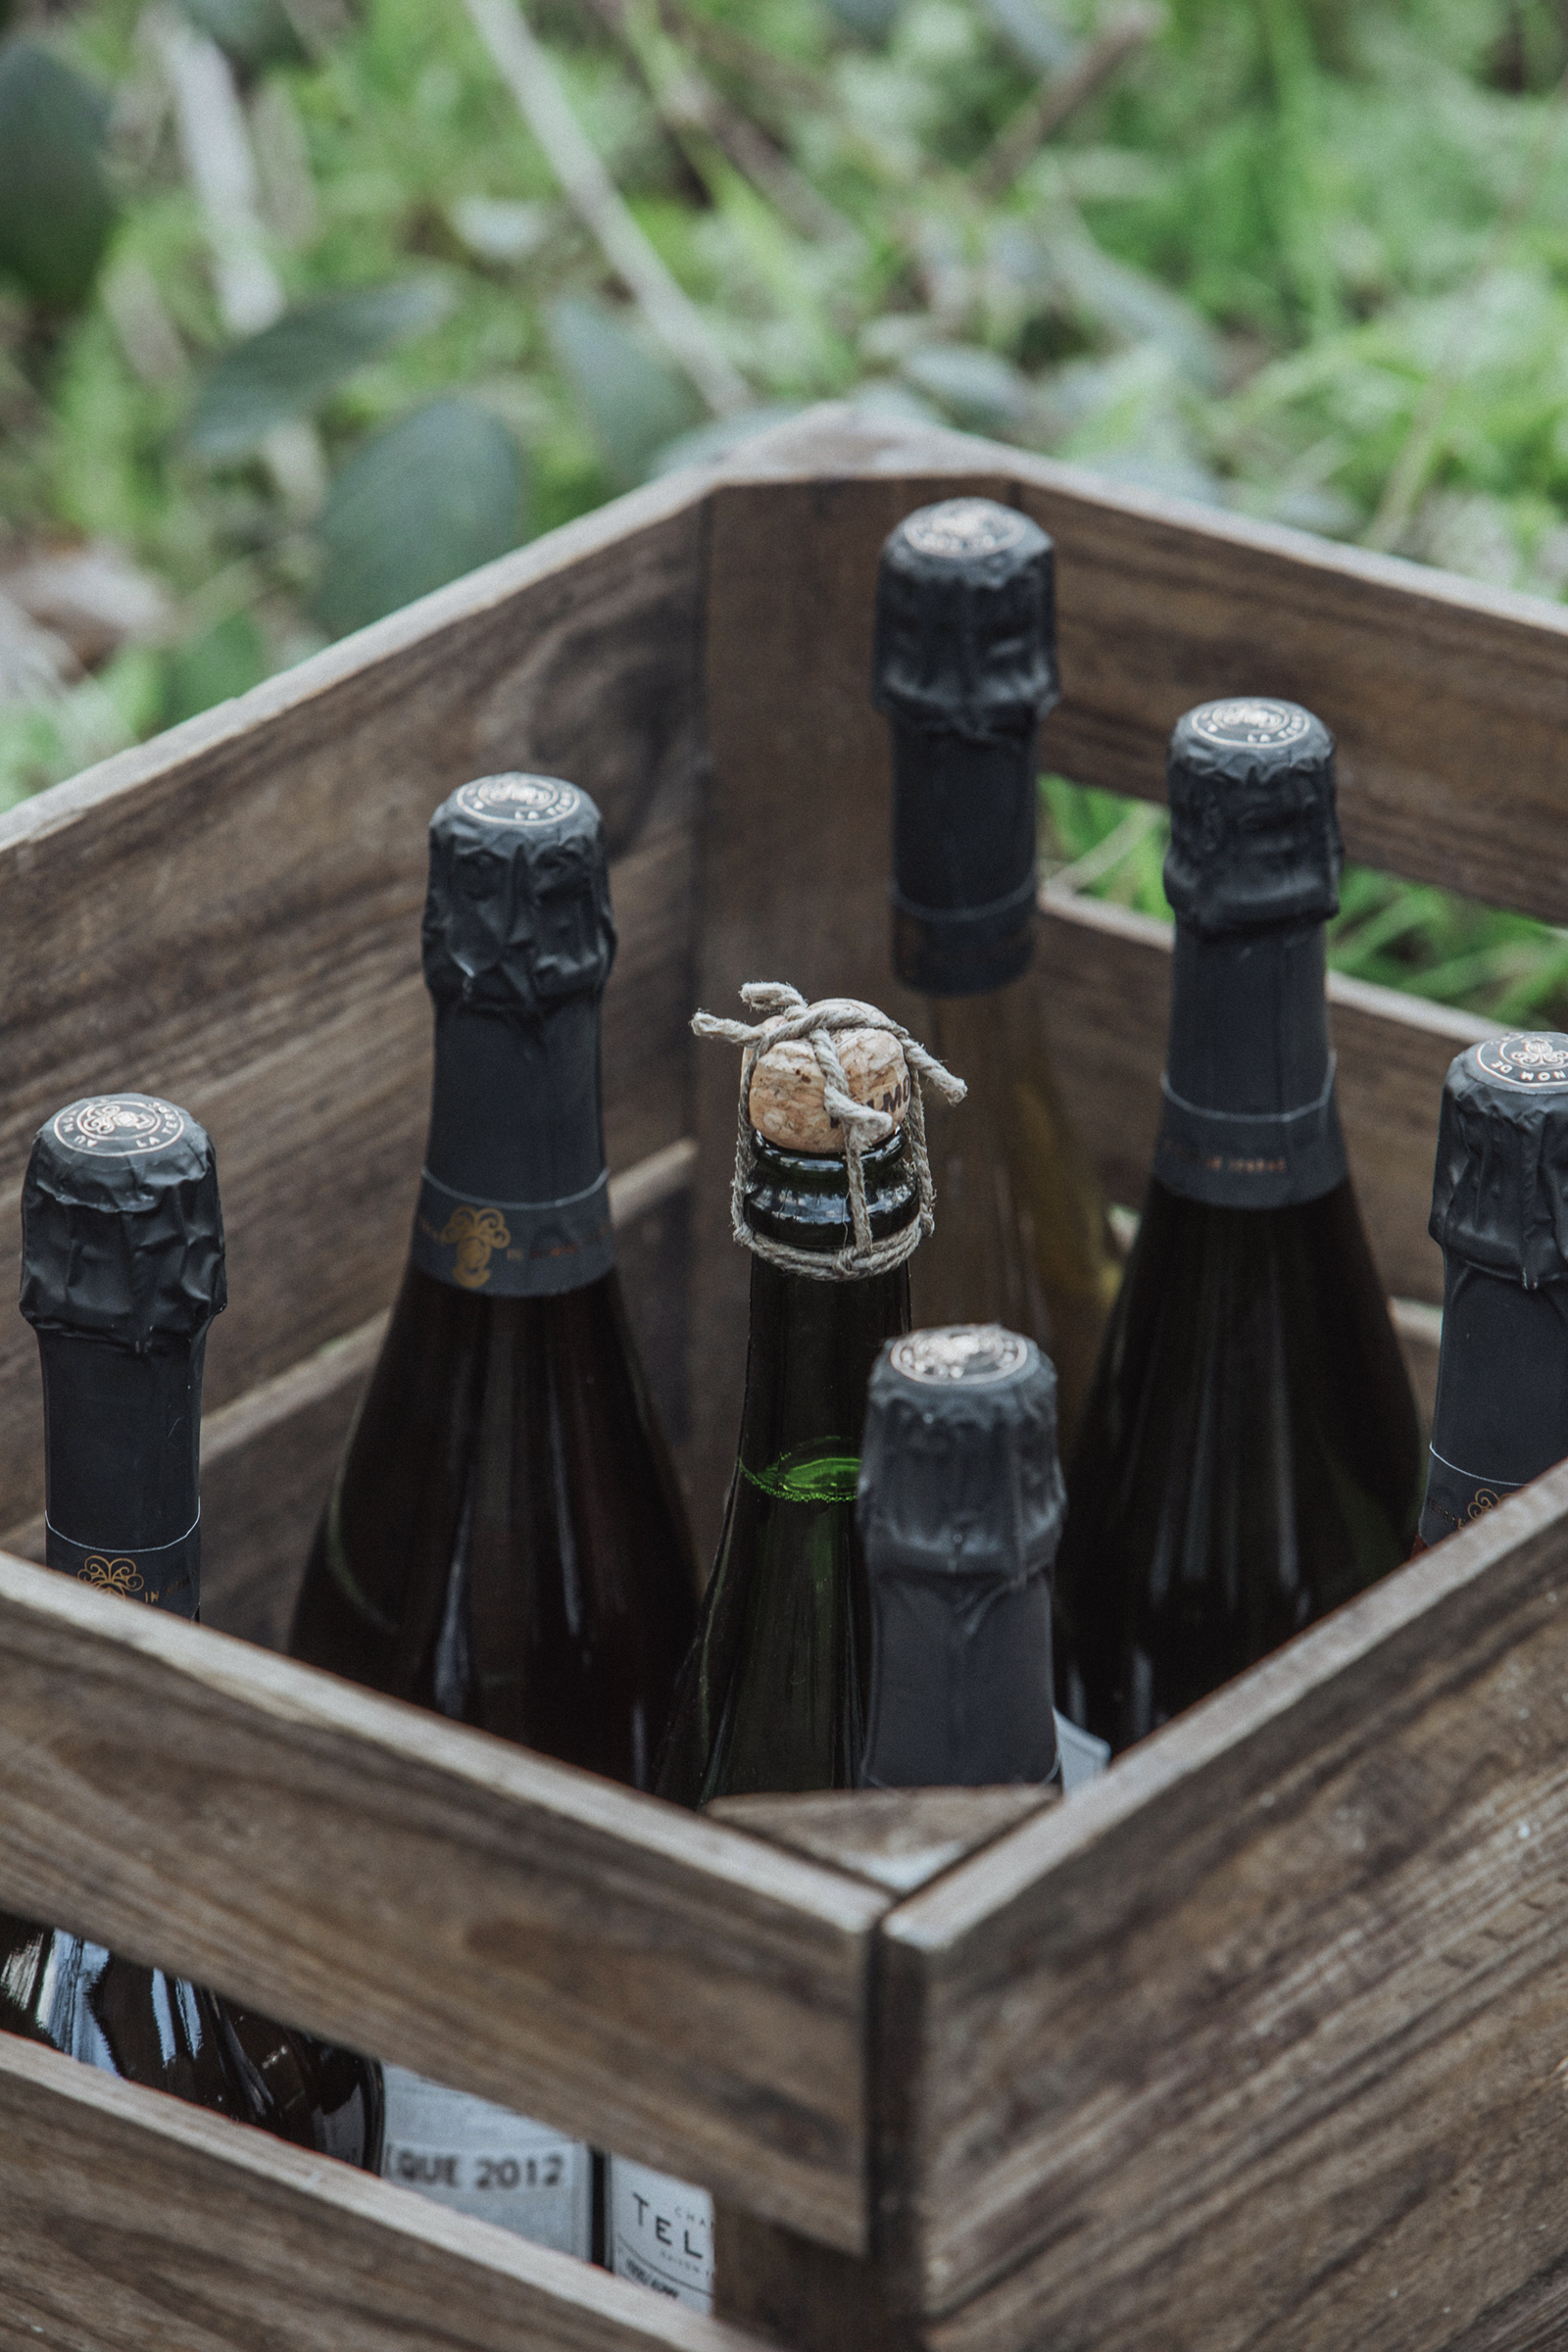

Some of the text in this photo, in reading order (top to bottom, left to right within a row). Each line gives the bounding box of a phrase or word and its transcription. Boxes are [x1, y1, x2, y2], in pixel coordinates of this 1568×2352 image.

[1491, 1060, 1566, 1082] NOM DE
[135, 1136, 161, 1149] LA
[473, 2154, 564, 2191] 2012
[632, 2191, 703, 2259] TEL
[674, 2205, 713, 2230] CHA
